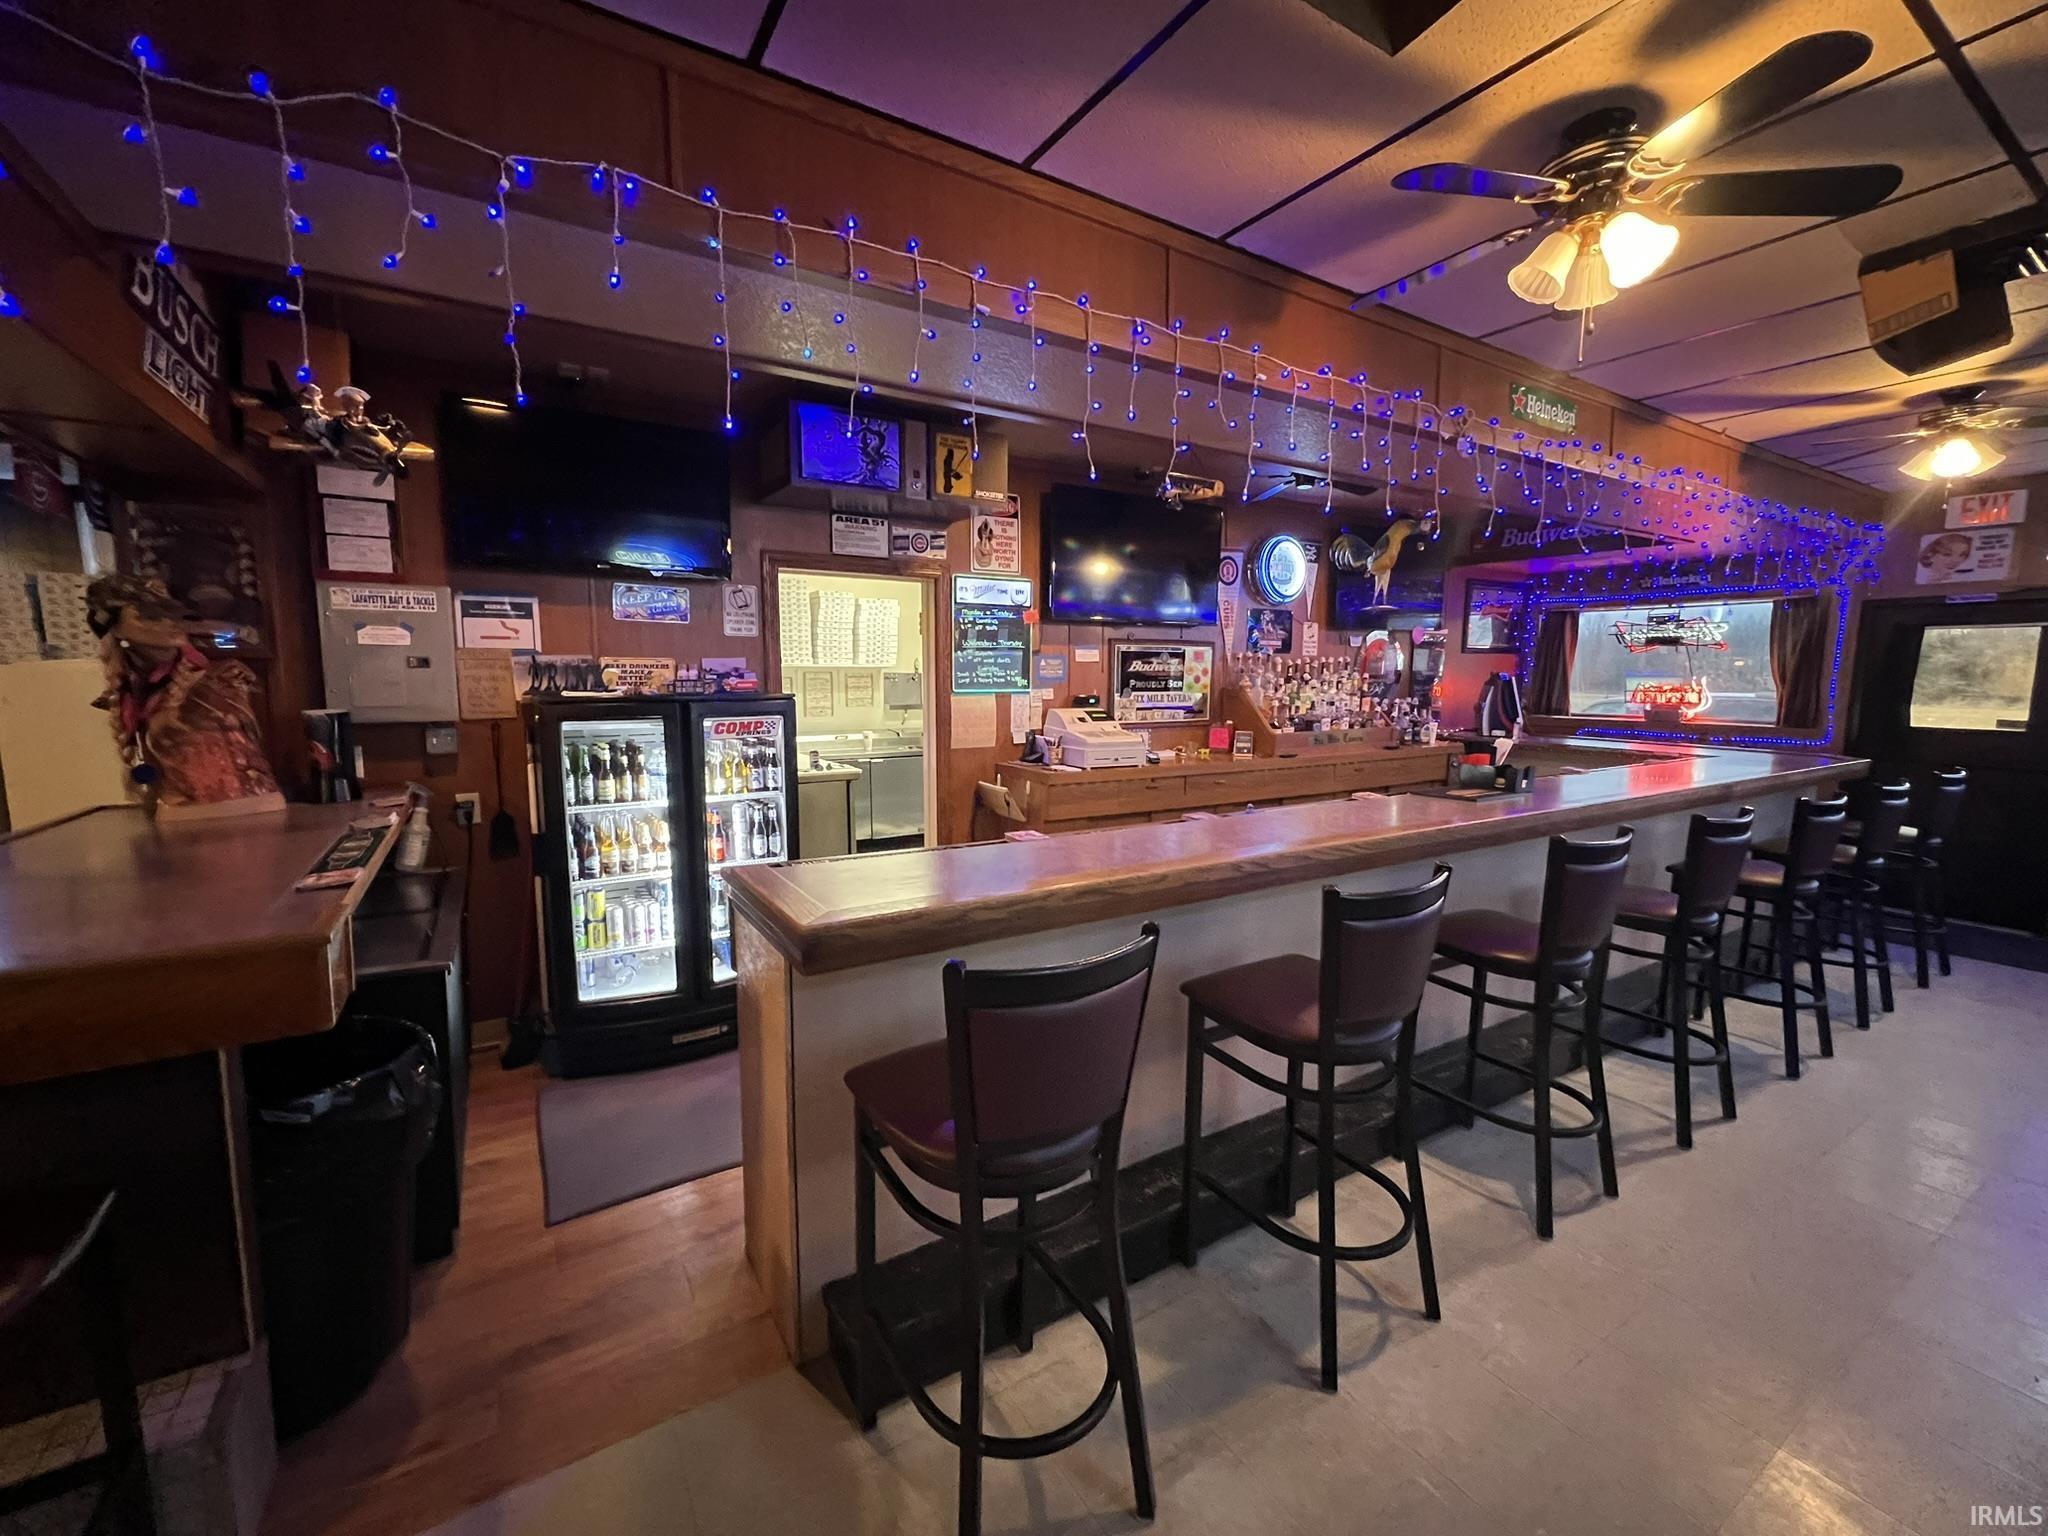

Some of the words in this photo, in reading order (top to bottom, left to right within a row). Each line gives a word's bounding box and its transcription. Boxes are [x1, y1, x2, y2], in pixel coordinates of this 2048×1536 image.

[131, 255, 219, 378] BUSCH
[1527, 393, 1577, 426] Heineken
[1961, 493, 2015, 525] EXIT
[835, 515, 870, 526] AREA
[1501, 524, 1611, 547] Budwese
[351, 594, 387, 604] LAFAYETTE
[389, 595, 404, 605] BAIT
[413, 596, 435, 606] TACKLE
[629, 663, 671, 671] DRINKERS
[1129, 679, 1166, 689] PROUDLY
[1146, 694, 1164, 703] MILE
[1166, 694, 1192, 703] TAVERN
[714, 720, 764, 735] COMP
[735, 729, 772, 737] SPRINGS
